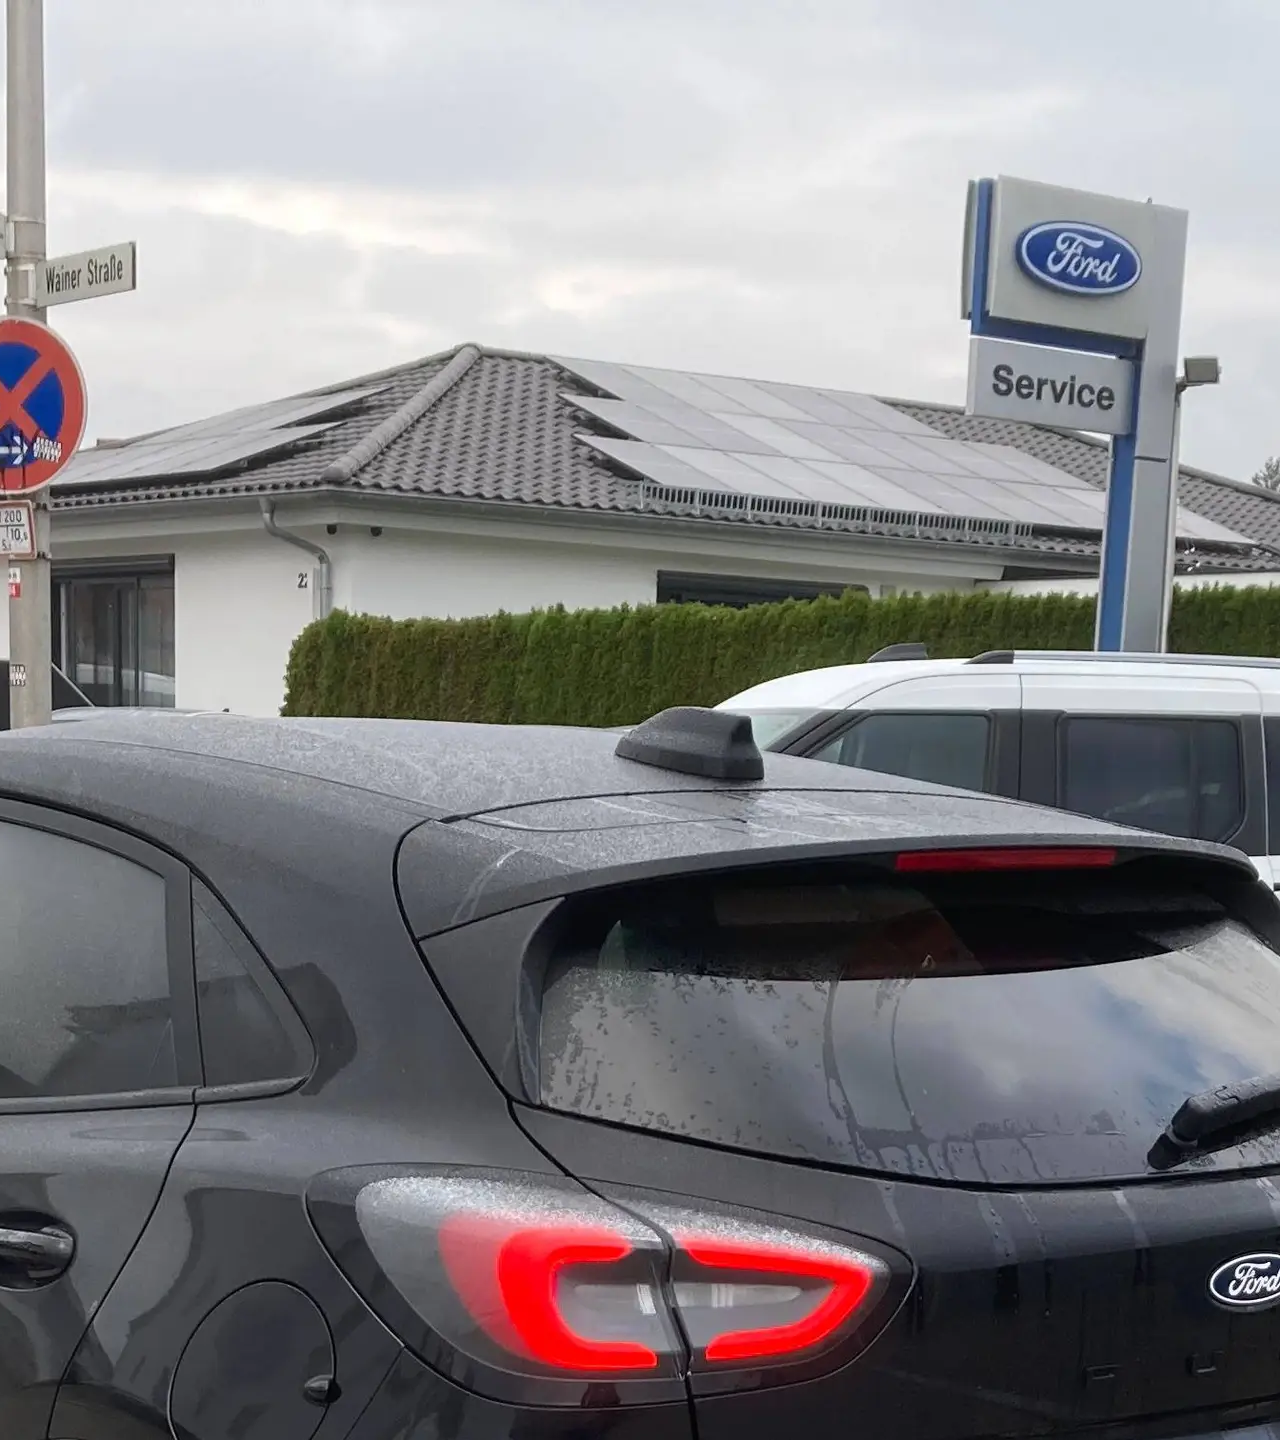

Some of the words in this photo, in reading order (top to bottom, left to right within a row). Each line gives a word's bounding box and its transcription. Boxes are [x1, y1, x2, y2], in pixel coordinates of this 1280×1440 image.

[45, 264, 82, 294] Wainer
[87, 253, 123, 287] Straße
[1047, 231, 1121, 284] Ford
[991, 364, 1116, 411] Service
[4, 510, 22, 523] 200
